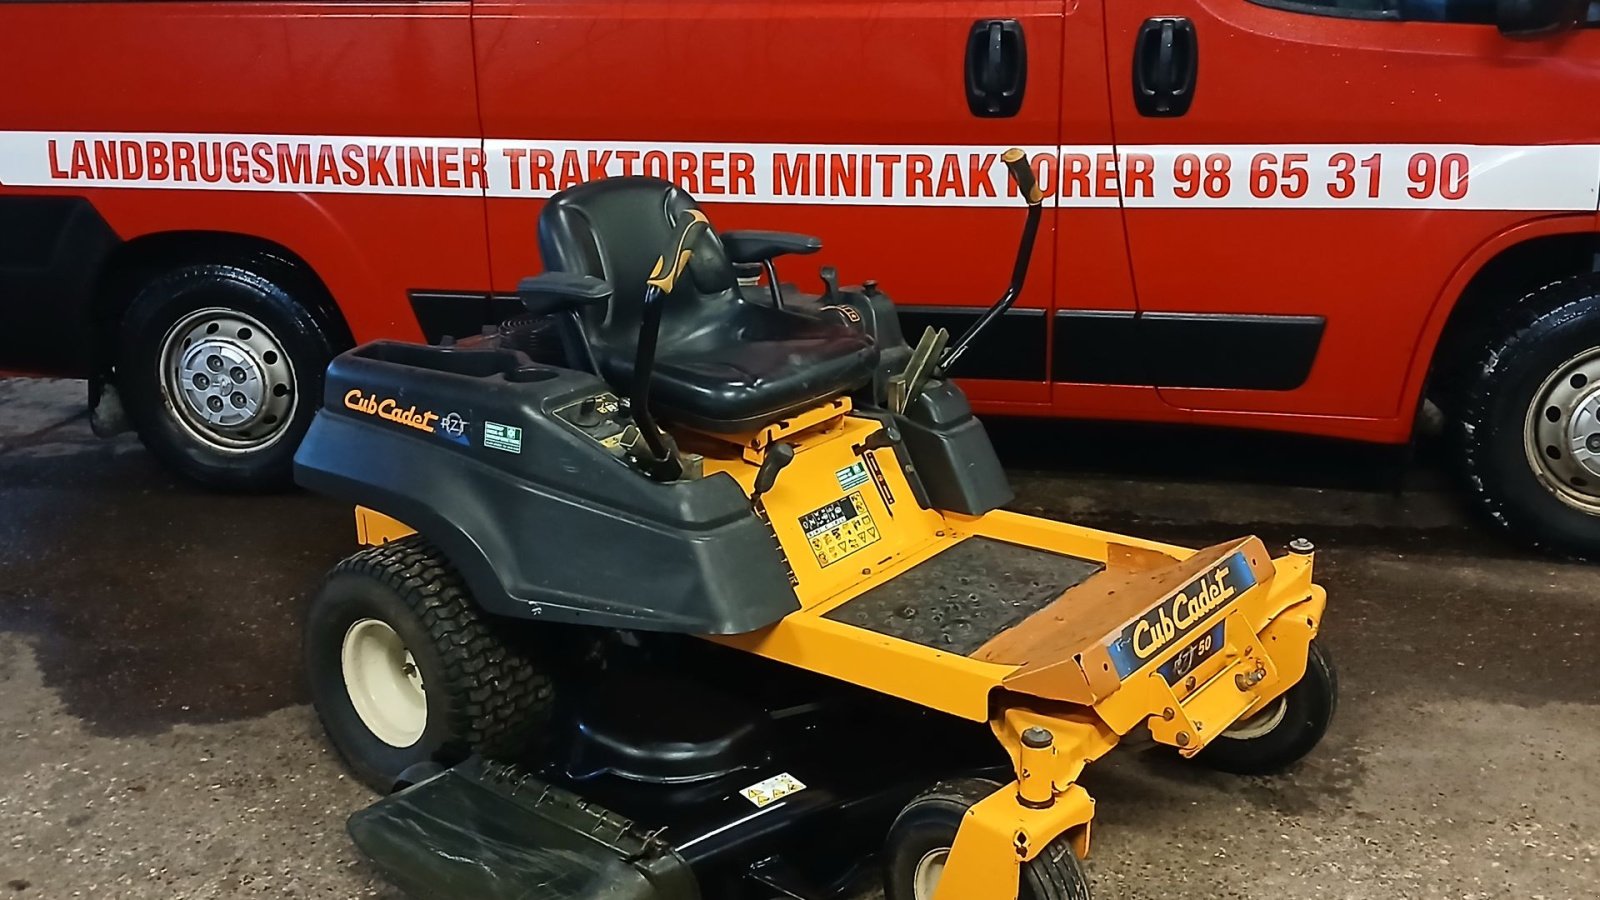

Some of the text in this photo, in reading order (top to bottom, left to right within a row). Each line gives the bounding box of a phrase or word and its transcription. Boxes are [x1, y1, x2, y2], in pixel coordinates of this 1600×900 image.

[47, 139, 489, 190] LANDBRUGSMASKINER
[502, 148, 756, 195] TRAKTORER
[1172, 152, 1232, 199] 98
[1249, 152, 1310, 199] 65
[1326, 152, 1382, 199] 31
[1407, 152, 1469, 200] 90
[344, 389, 439, 433] Cub Cadet
[440, 412, 470, 436] RZT
[1132, 566, 1235, 659] Cub Cadet
[1197, 634, 1212, 656] 50
